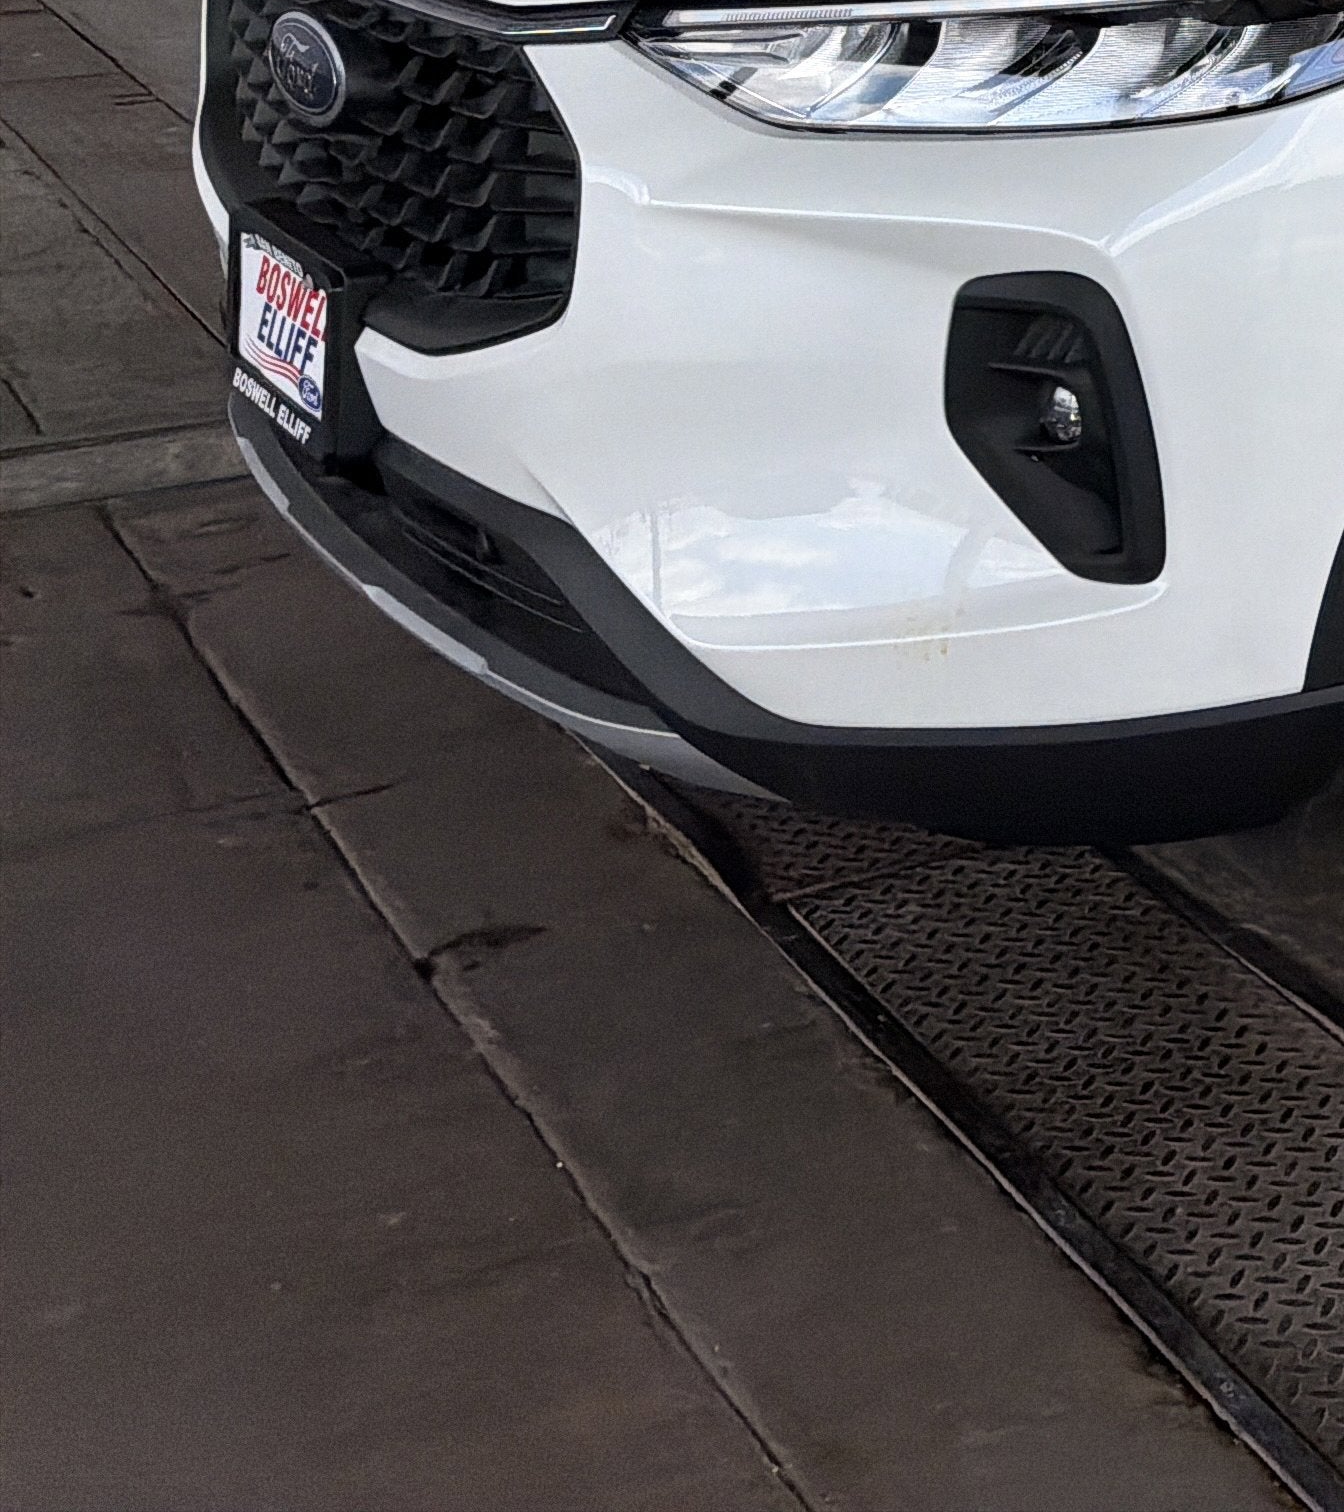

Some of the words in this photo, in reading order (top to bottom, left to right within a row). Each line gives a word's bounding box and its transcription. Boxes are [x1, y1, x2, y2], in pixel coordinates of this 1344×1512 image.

[255, 254, 327, 343] BOSWEL
[256, 301, 319, 375] ELLIFF
[232, 366, 276, 419] BOSWELL
[276, 403, 312, 445] ELLIFF
[301, 378, 320, 409] Ford
